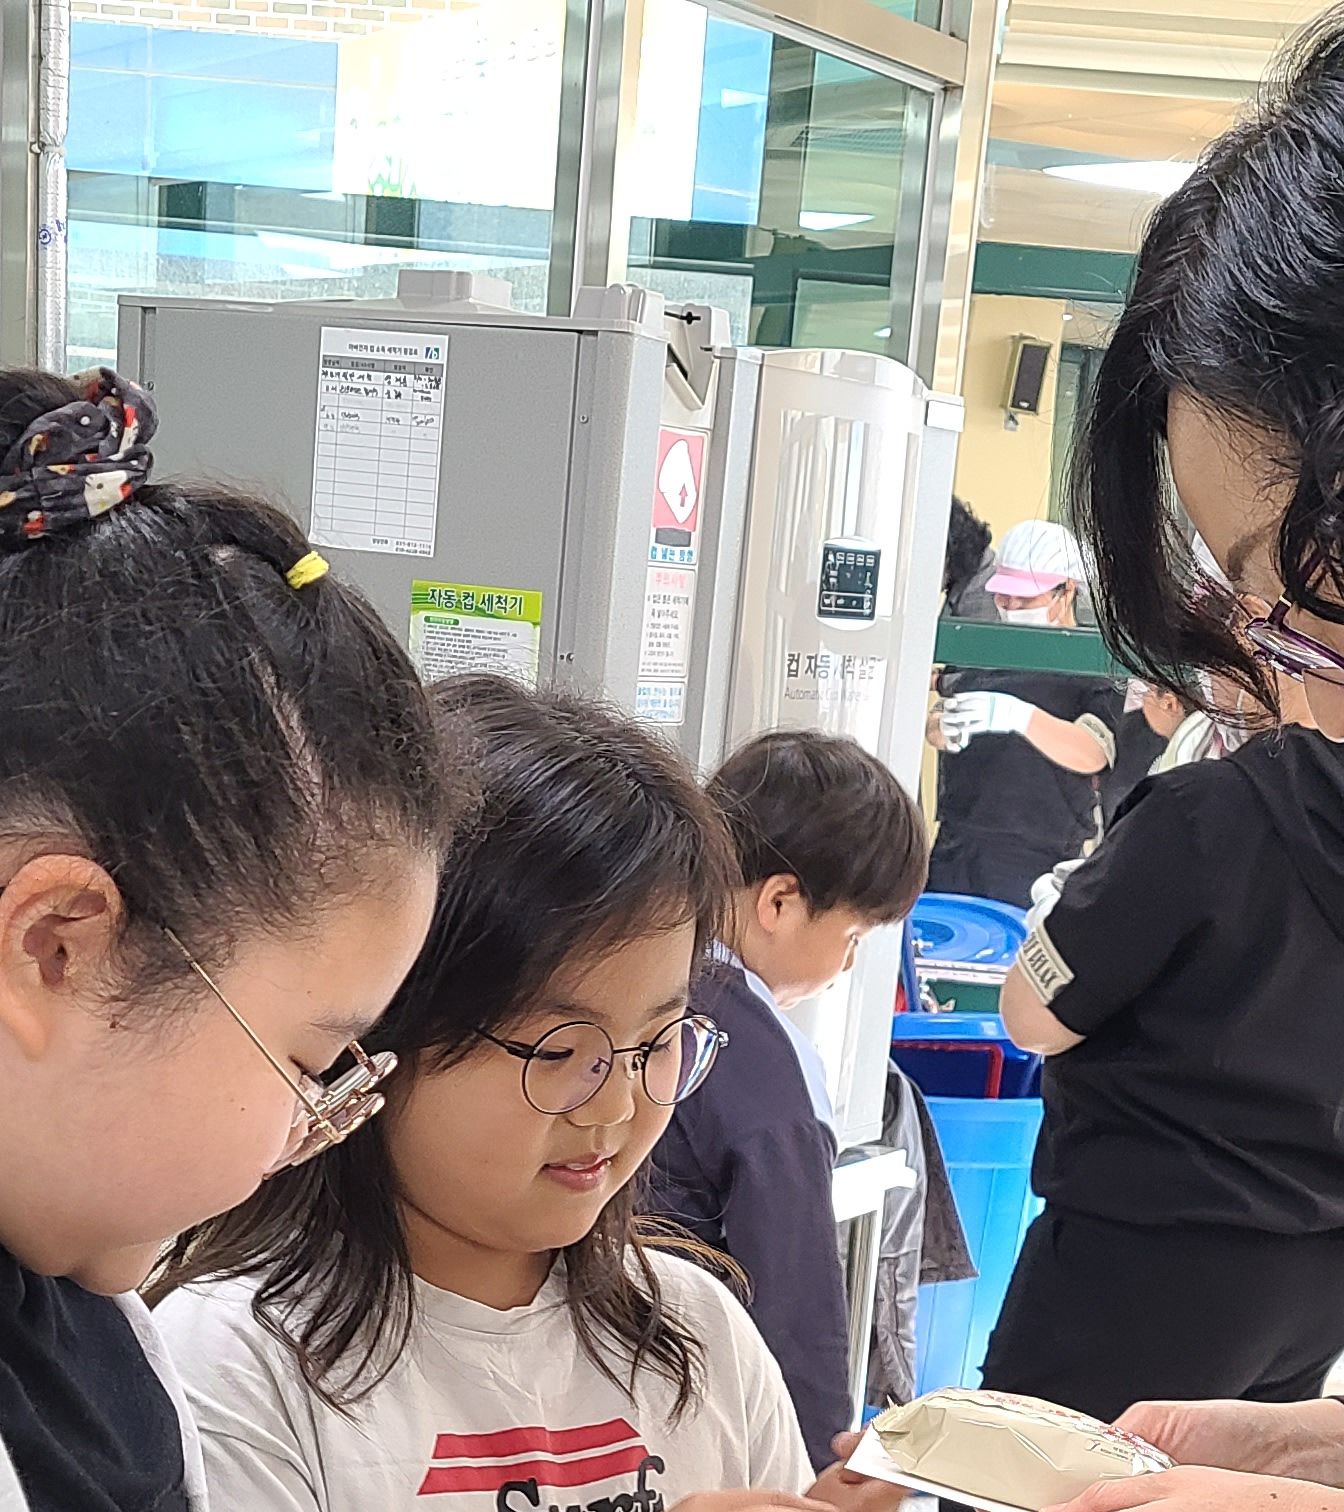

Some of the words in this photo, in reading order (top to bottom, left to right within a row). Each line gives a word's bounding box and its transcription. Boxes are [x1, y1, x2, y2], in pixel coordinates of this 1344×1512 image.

[428, 588, 456, 609] 자동
[461, 591, 475, 610] 컵
[480, 593, 524, 615] 세척기
[786, 652, 801, 678] 컵
